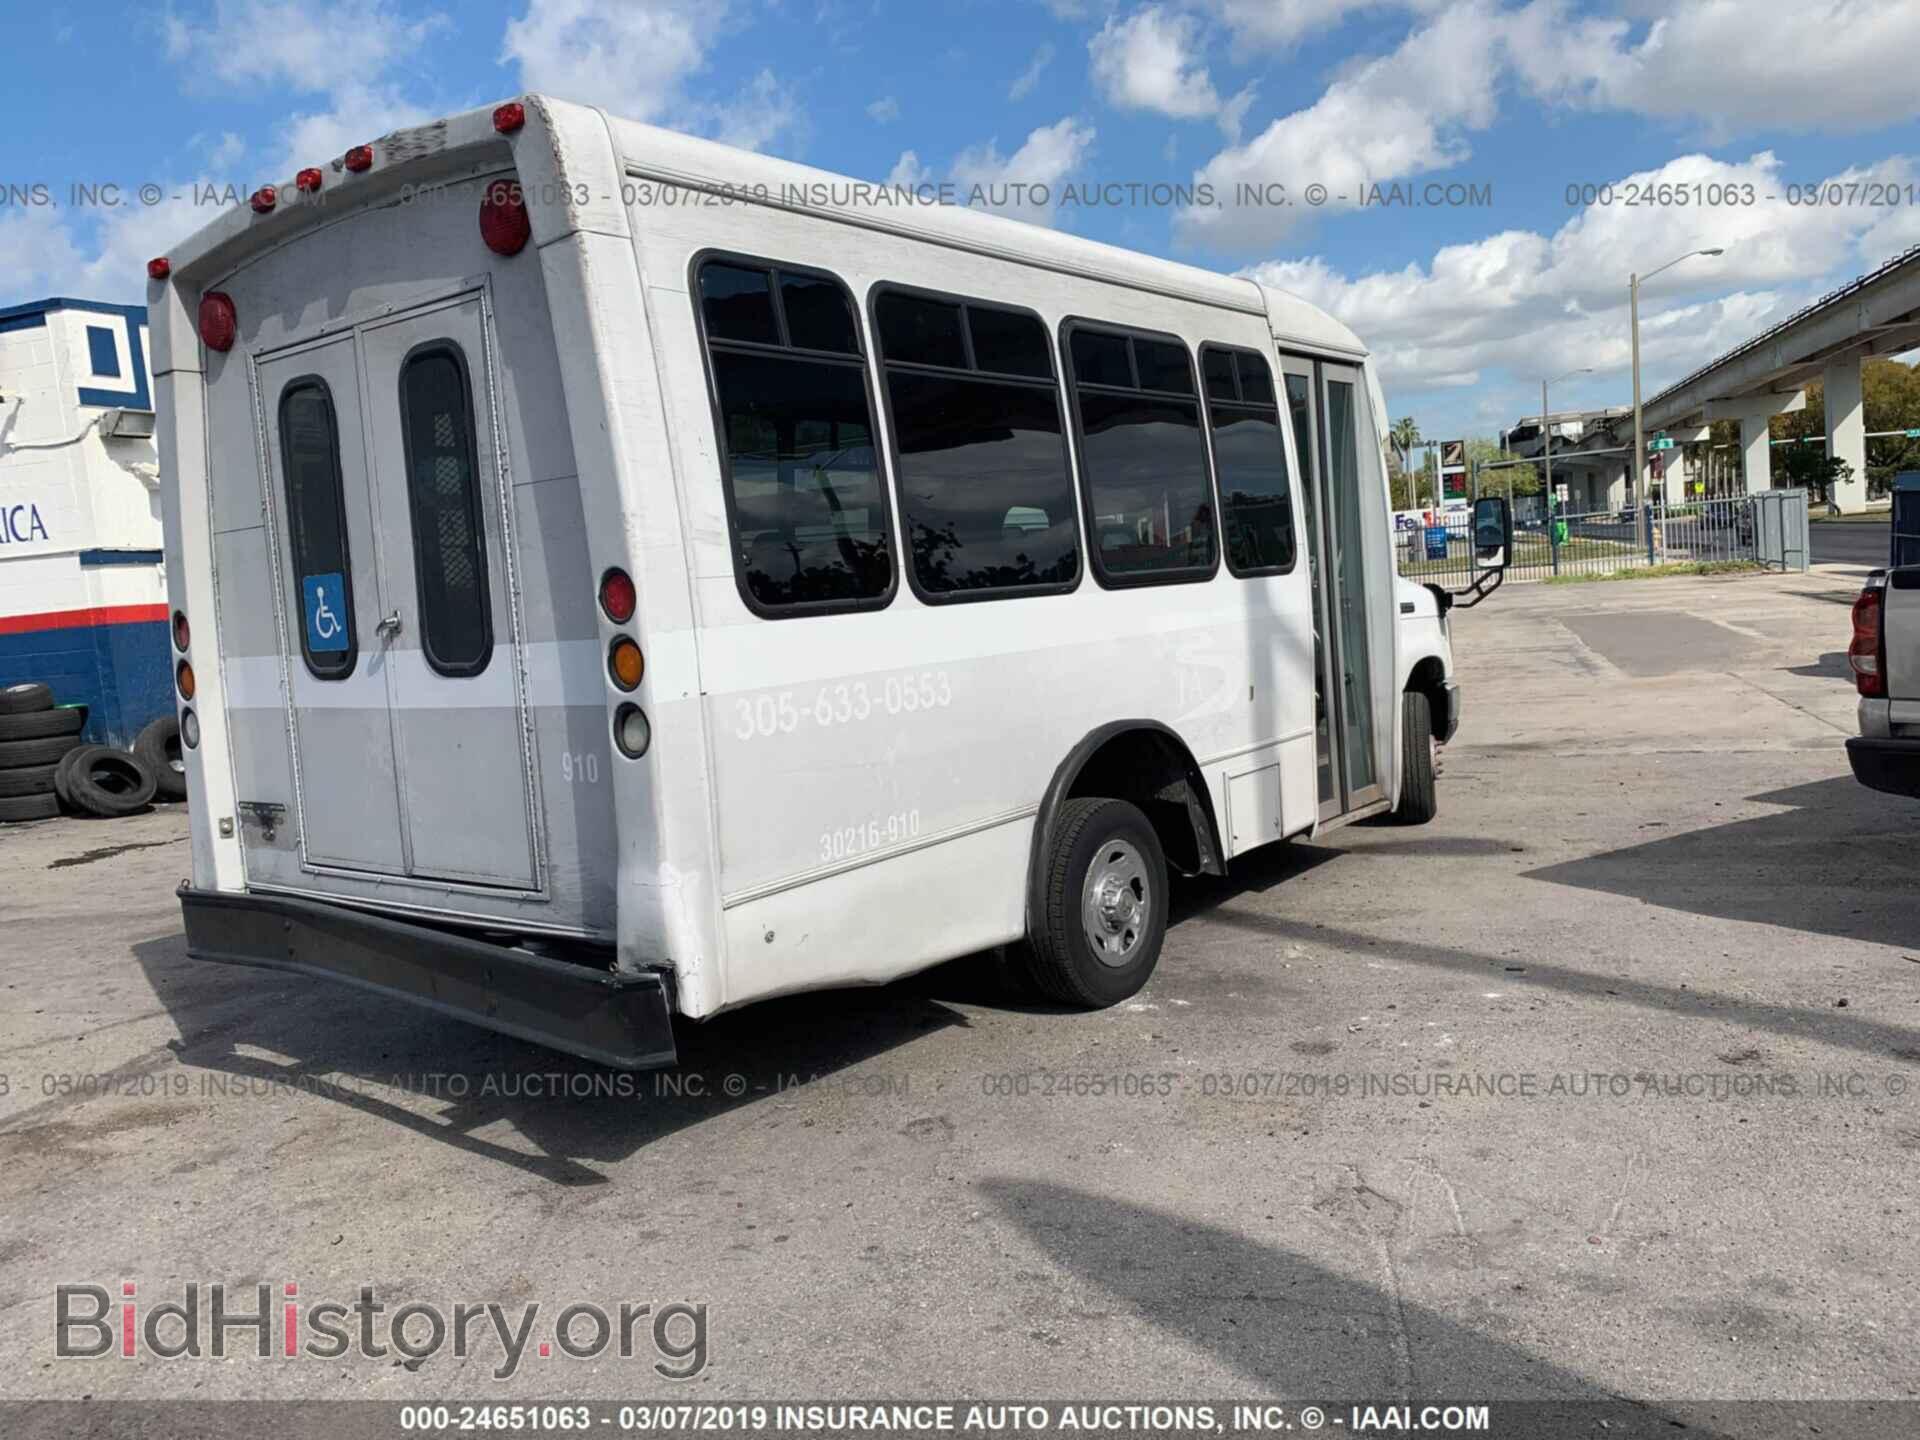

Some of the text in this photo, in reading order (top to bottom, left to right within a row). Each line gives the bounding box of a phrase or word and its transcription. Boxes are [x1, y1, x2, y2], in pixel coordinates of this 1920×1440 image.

[0, 504, 49, 543] ICA
[735, 671, 952, 741] 305-633-0553
[562, 751, 599, 783] 910
[819, 809, 920, 861] 30216-910
